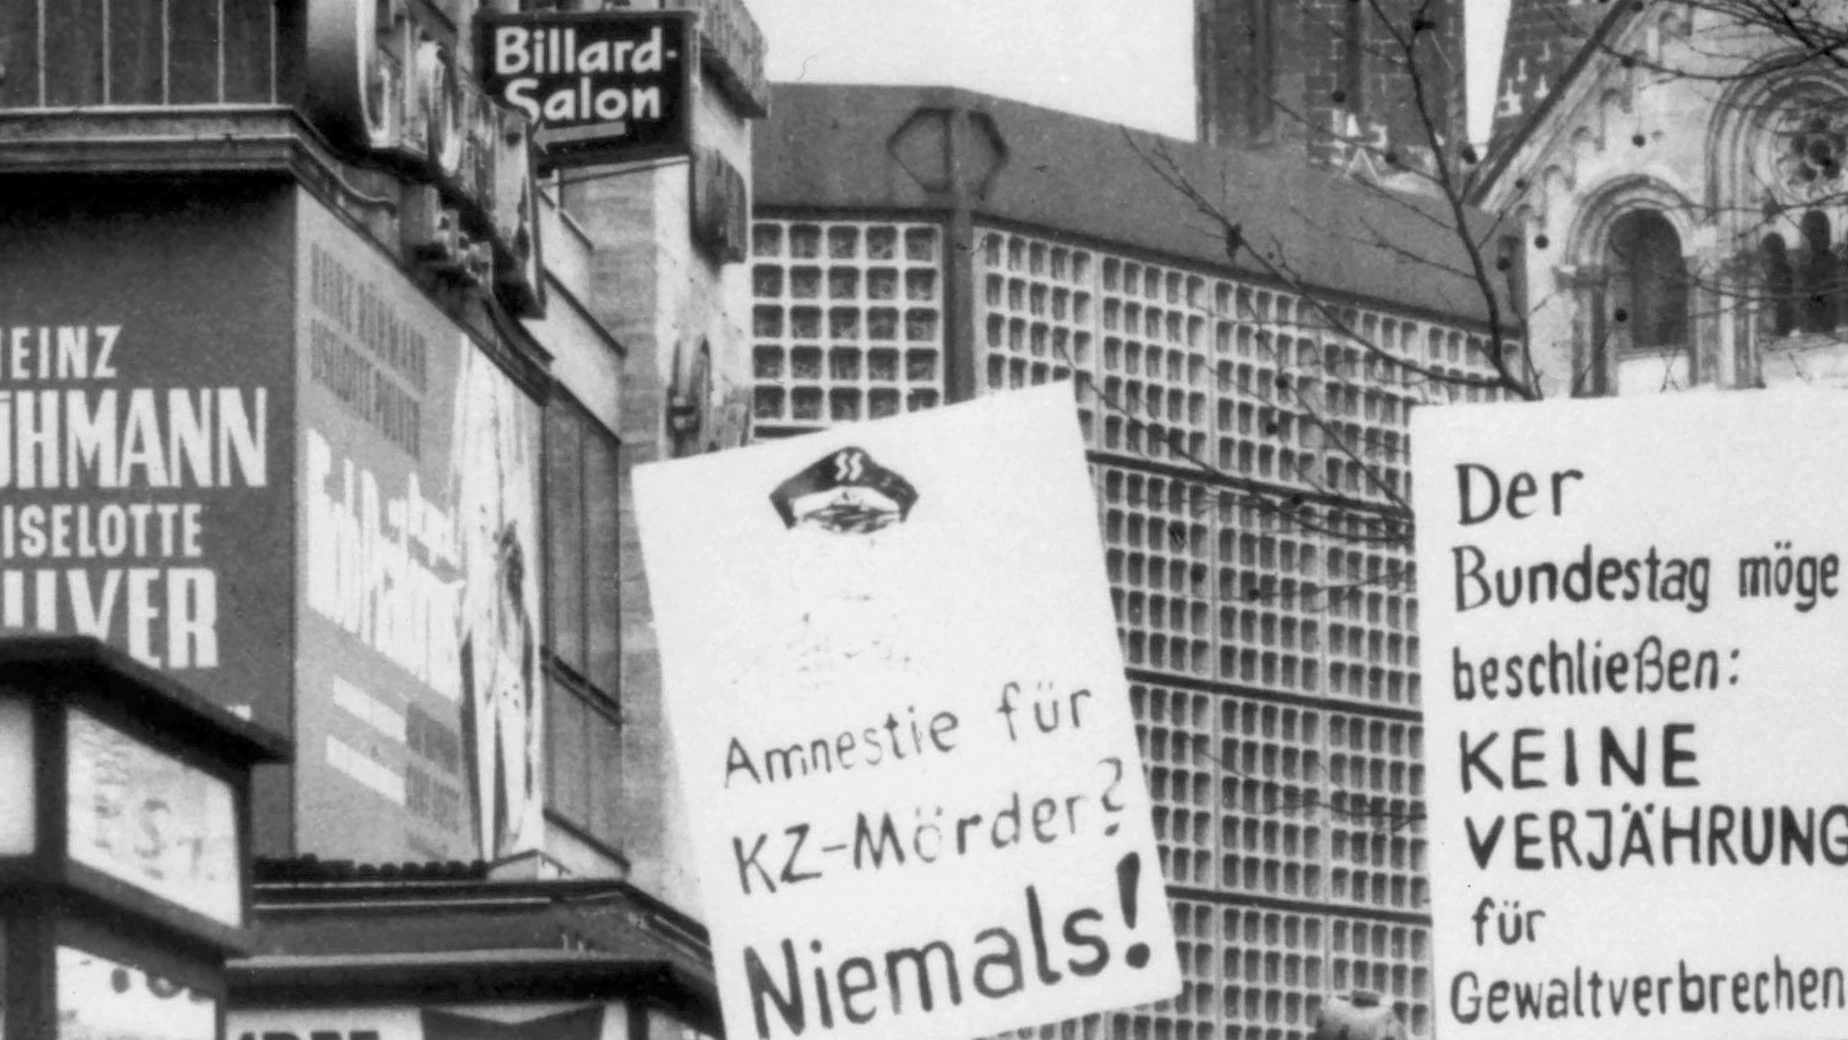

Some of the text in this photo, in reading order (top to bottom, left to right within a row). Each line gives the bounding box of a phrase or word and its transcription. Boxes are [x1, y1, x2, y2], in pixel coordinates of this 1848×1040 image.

[496, 27, 677, 73] Billard-
[505, 77, 660, 125] Salon
[0, 325, 121, 379] EINZ
[0, 387, 267, 489] HMANN
[1454, 463, 1585, 525] Der
[1451, 540, 1840, 612] Bundestag möge
[1452, 635, 1741, 700] beschließen:
[724, 680, 1092, 789] Amnestie für
[1459, 723, 1700, 792] KEINE
[732, 756, 1124, 896] KZ-Mörder?
[743, 851, 1151, 1040] Niemals!
[1471, 897, 1546, 946] für
